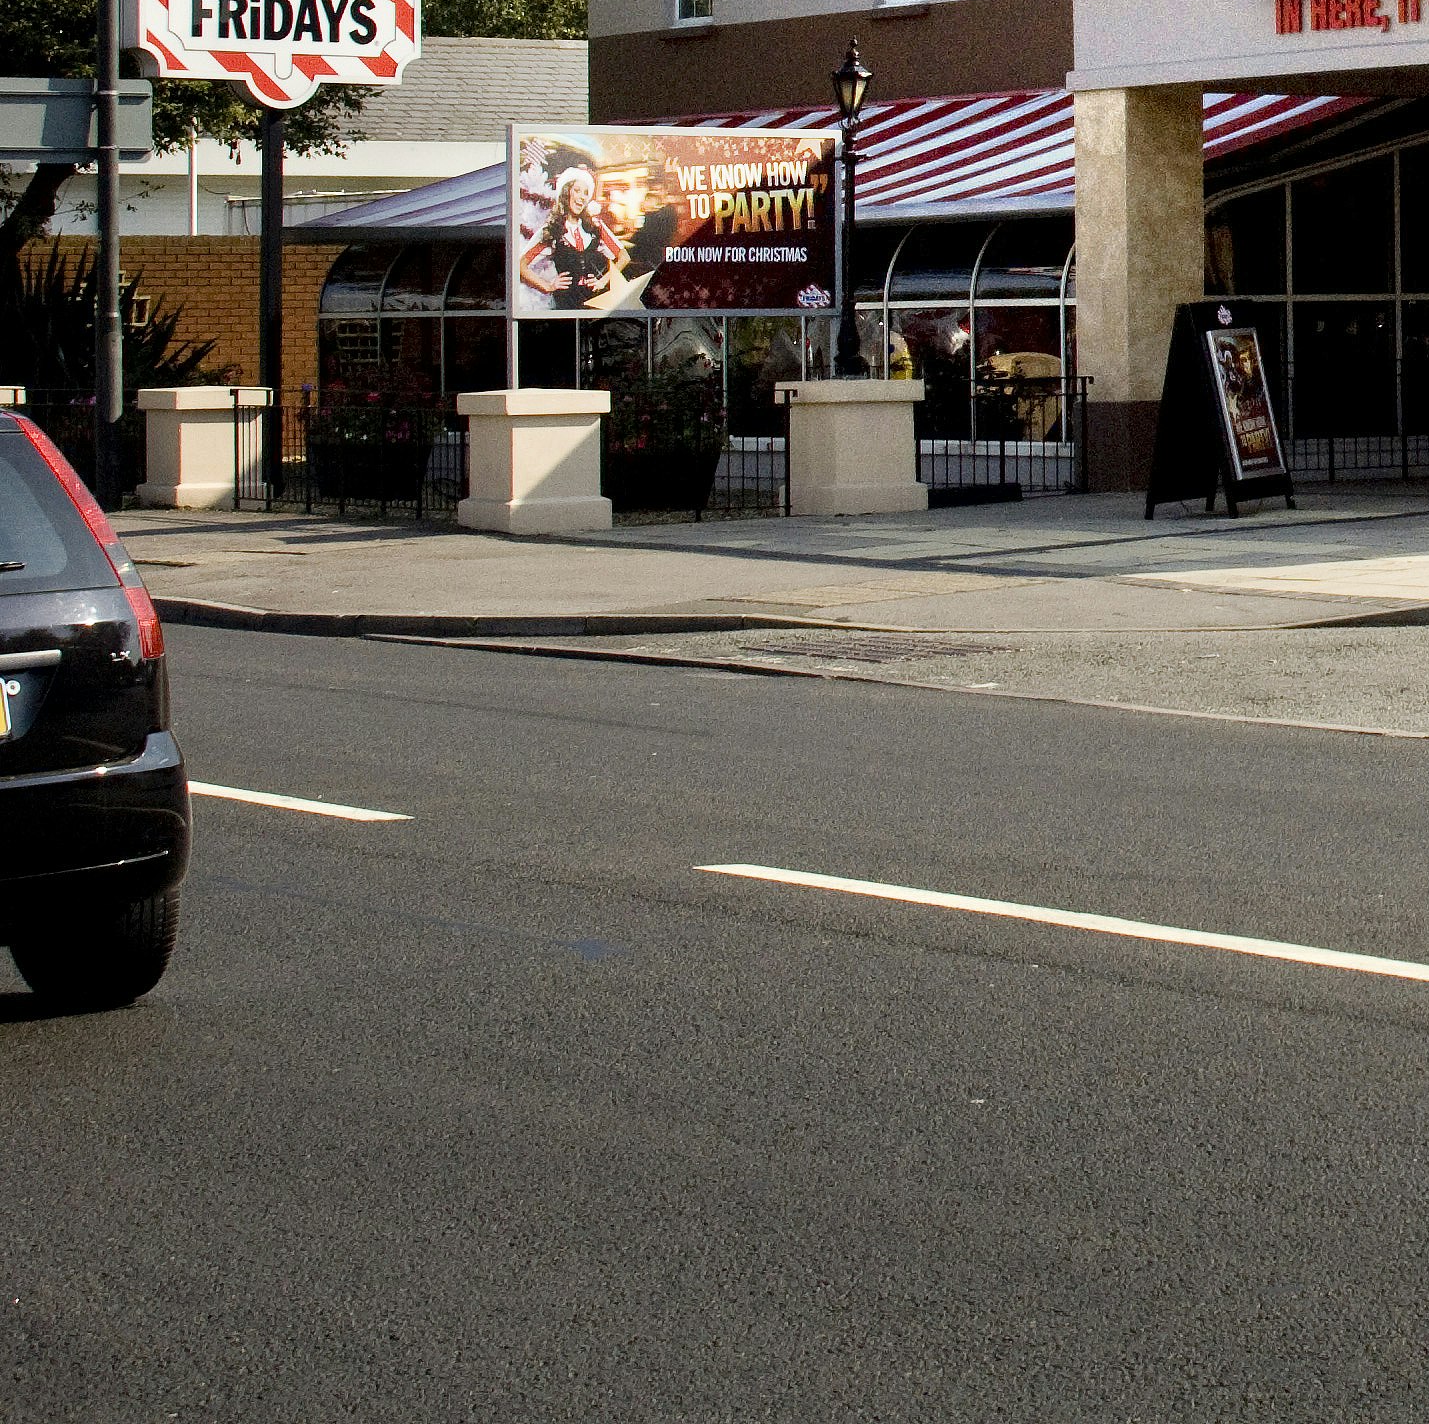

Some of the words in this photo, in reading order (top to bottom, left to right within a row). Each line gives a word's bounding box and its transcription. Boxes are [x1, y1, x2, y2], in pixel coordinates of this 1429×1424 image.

[709, 163, 763, 190] KNOW
[765, 160, 808, 188] HOW
[686, 193, 711, 220] TO
[665, 246, 697, 263] BOOK
[697, 247, 723, 263] NOW
[724, 246, 747, 263] FOR
[748, 246, 808, 263] CHRISTMAS
